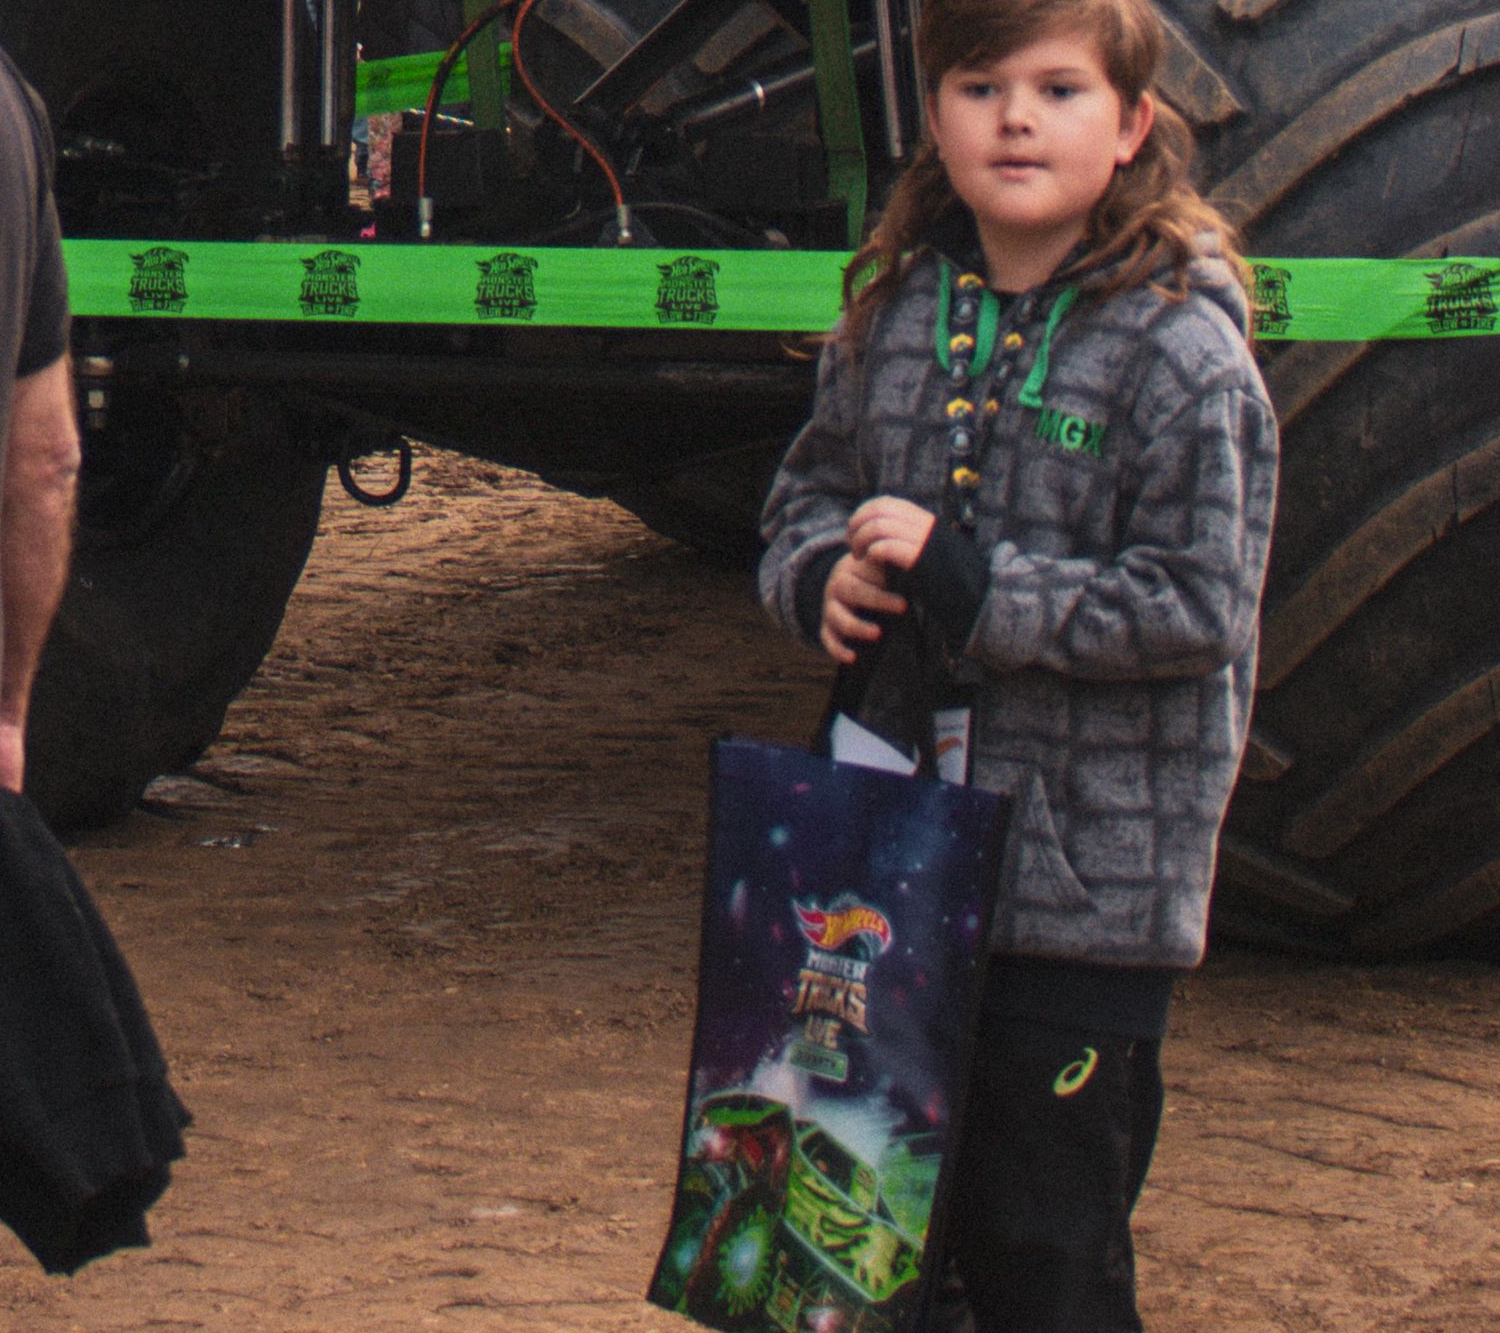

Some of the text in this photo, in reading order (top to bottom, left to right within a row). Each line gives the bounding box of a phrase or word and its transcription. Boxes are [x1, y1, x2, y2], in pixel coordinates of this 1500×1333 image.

[132, 277, 184, 295] TRUCKS
[302, 281, 356, 298] TRUCKS
[478, 284, 533, 301] TRUCKS
[657, 288, 716, 306] TRUCKS
